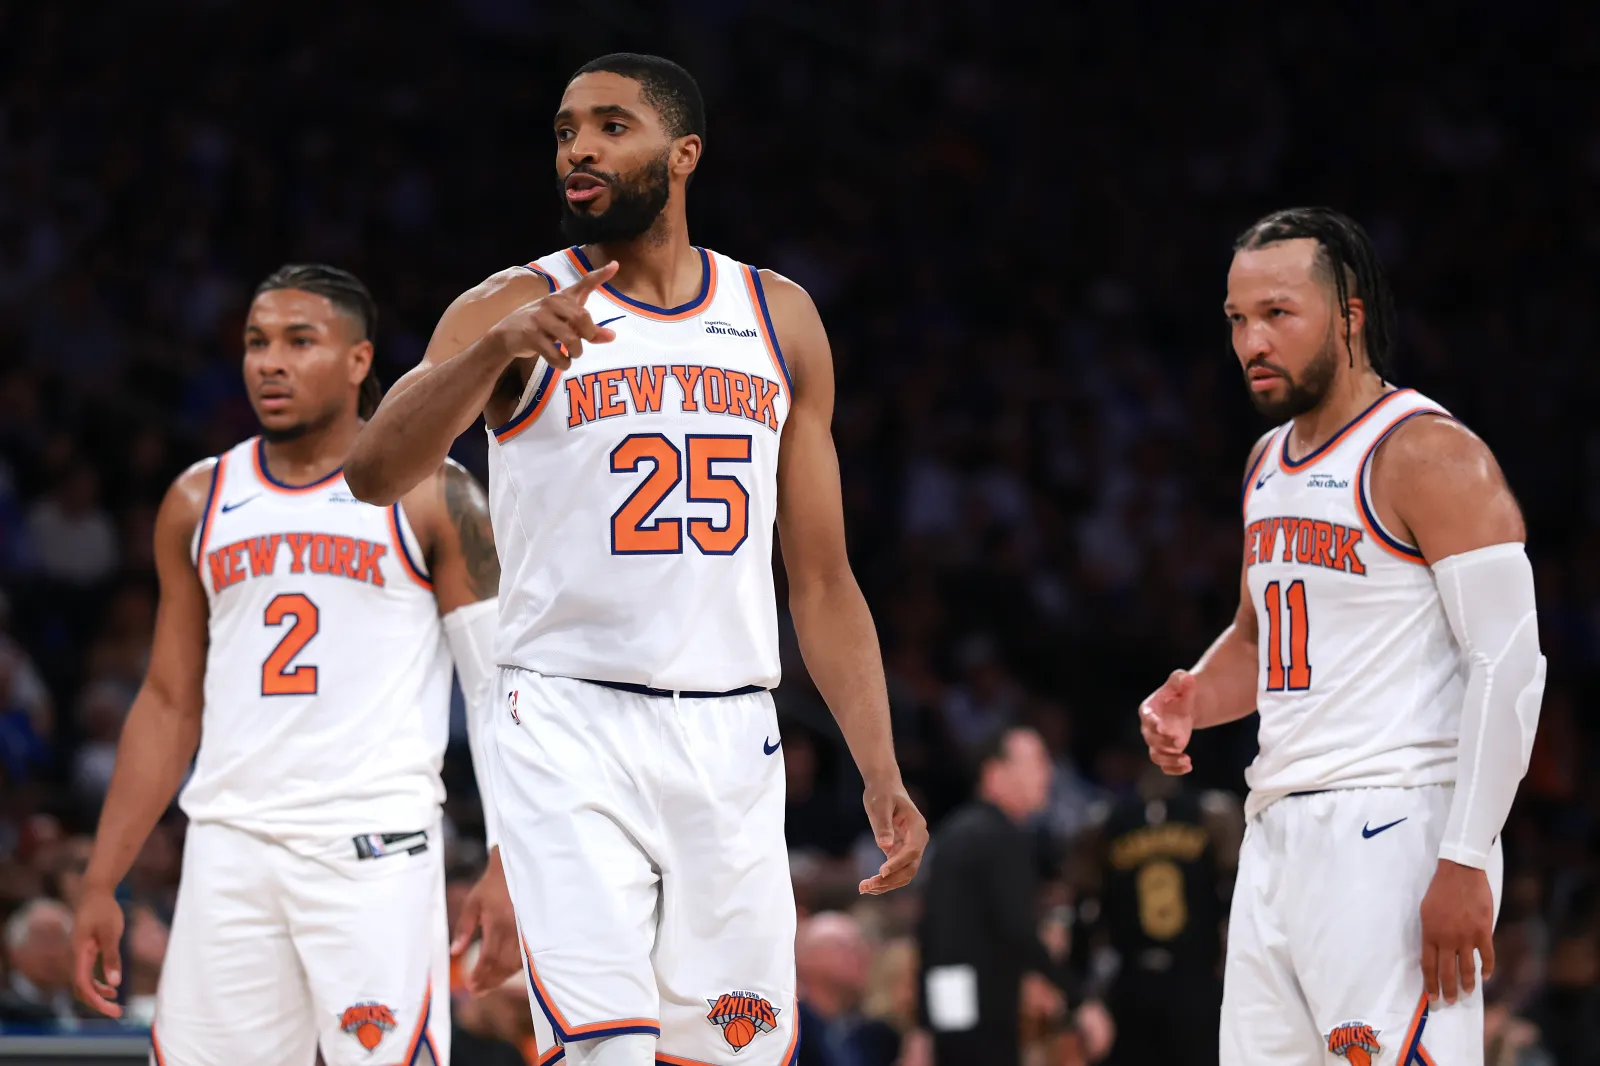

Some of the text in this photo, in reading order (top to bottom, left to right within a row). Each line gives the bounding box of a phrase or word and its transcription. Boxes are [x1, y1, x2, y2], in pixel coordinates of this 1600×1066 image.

[705, 325, 758, 338] abu dhabi
[563, 364, 781, 435] NEW YORK
[610, 432, 752, 555] 25
[208, 532, 388, 595] NEW YORK
[1246, 516, 1367, 577] EW YORK
[261, 592, 319, 697] 2
[1264, 579, 1312, 692] 11
[341, 1004, 396, 1031] KNICKS
[707, 993, 777, 1029] KNICKS
[1328, 1025, 1380, 1053] KNICKS
